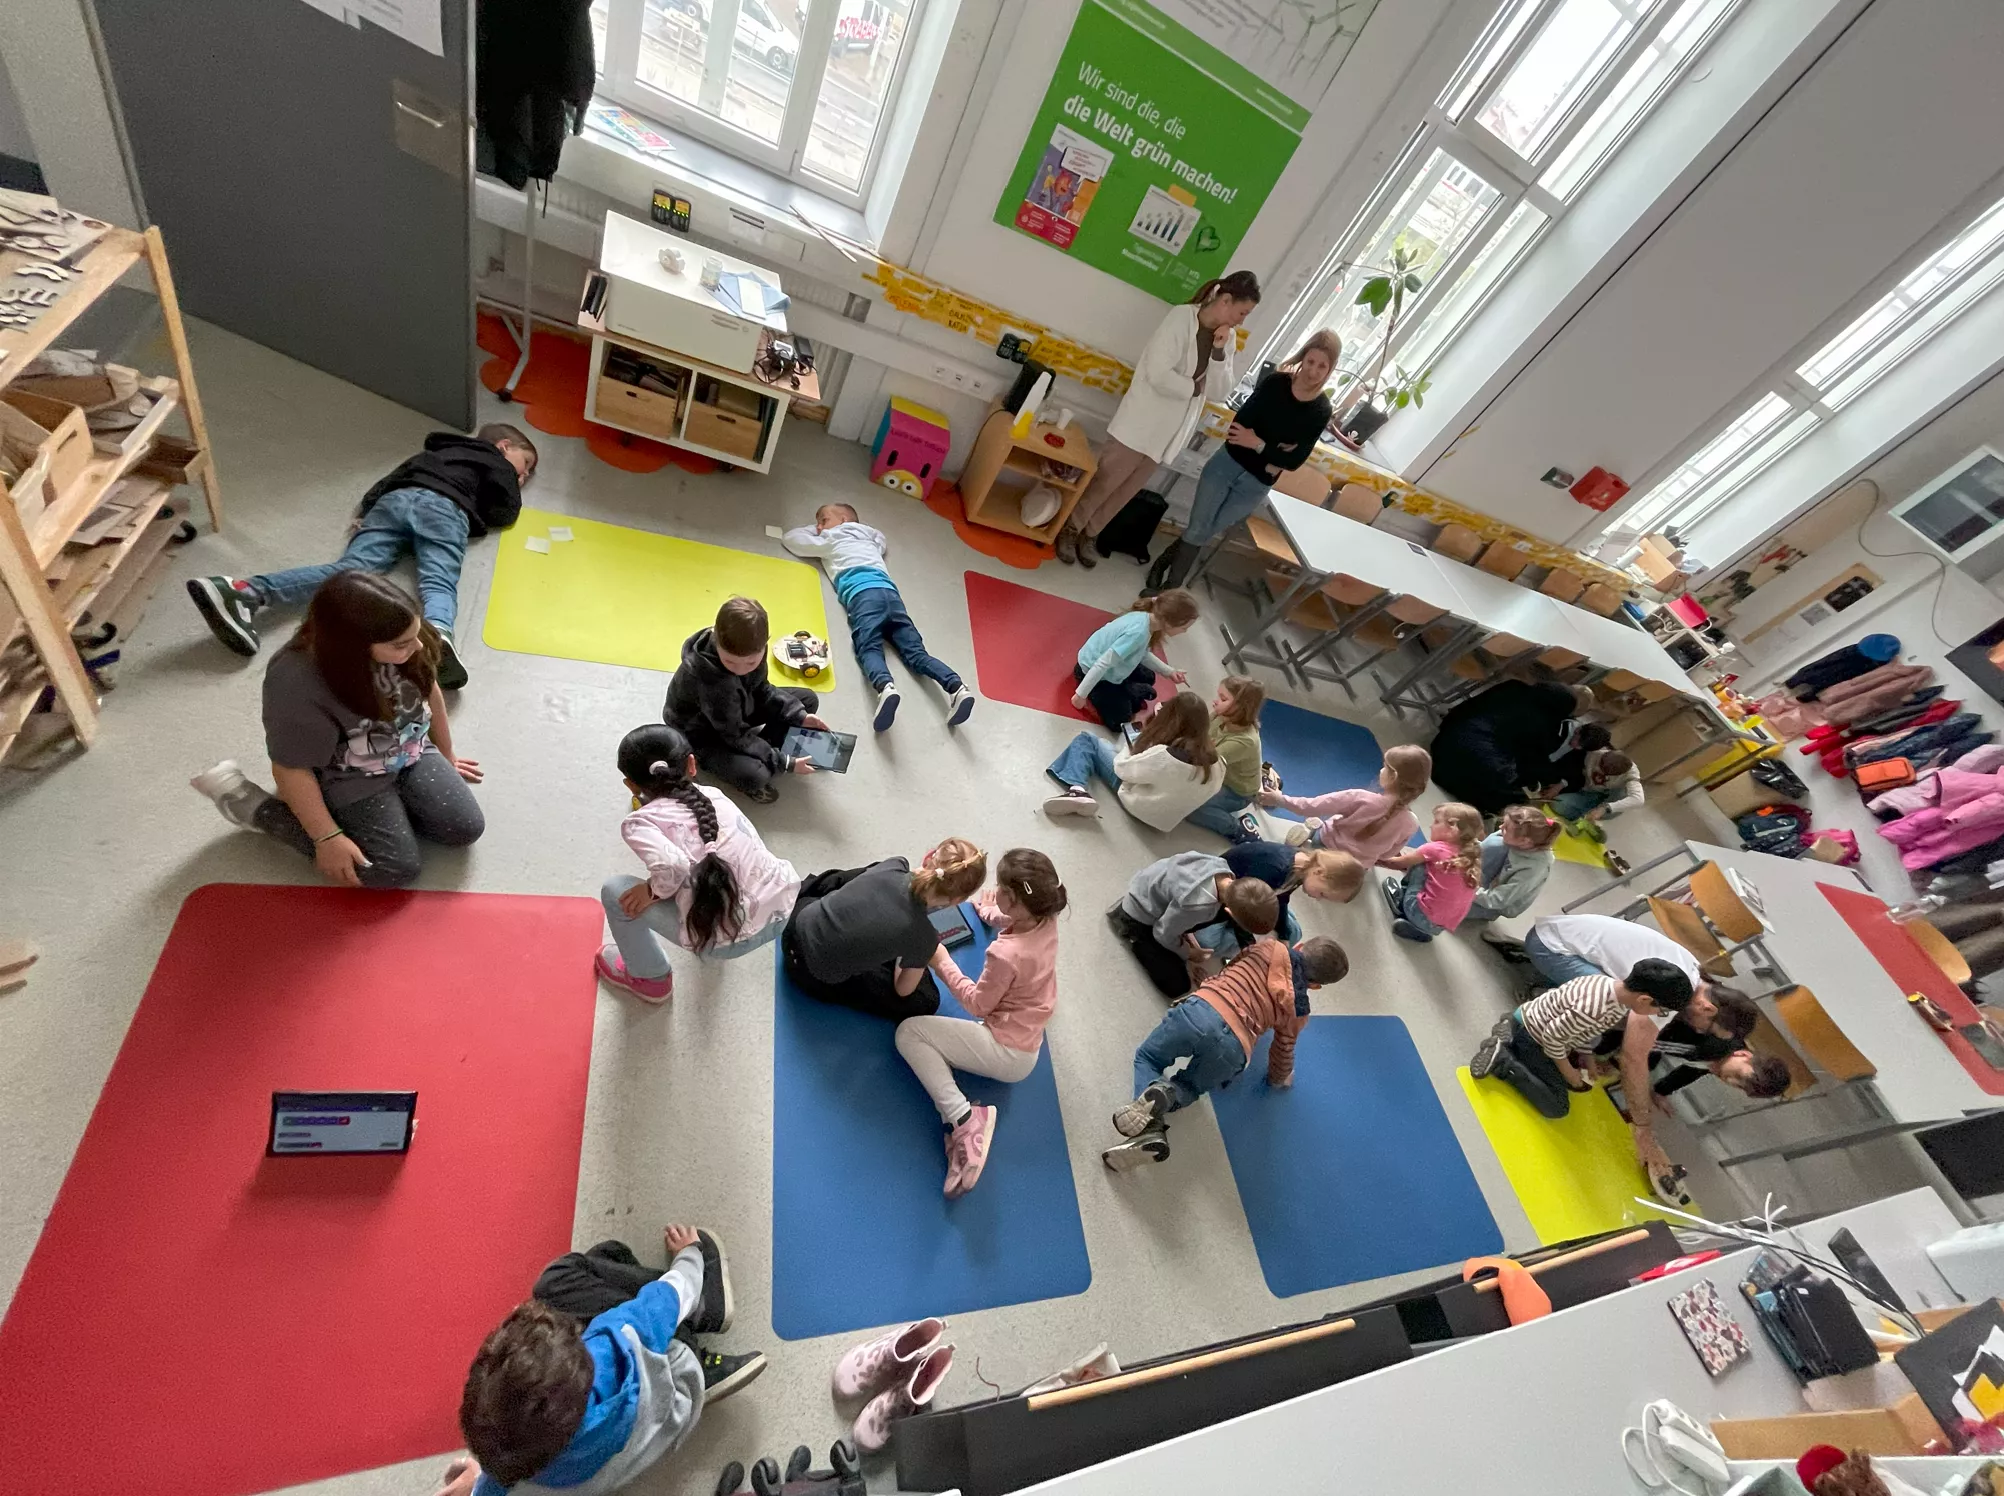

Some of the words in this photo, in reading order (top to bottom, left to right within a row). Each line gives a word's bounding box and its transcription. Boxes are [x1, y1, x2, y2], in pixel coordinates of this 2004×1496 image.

[1078, 60, 1105, 92] Wir
[1104, 81, 1140, 111] sind
[1137, 99, 1160, 129] die,
[1163, 116, 1186, 140] die
[1063, 94, 1092, 123] die
[1093, 107, 1135, 147] Welt
[1130, 137, 1172, 169] grün
[1171, 159, 1239, 205] machen!
